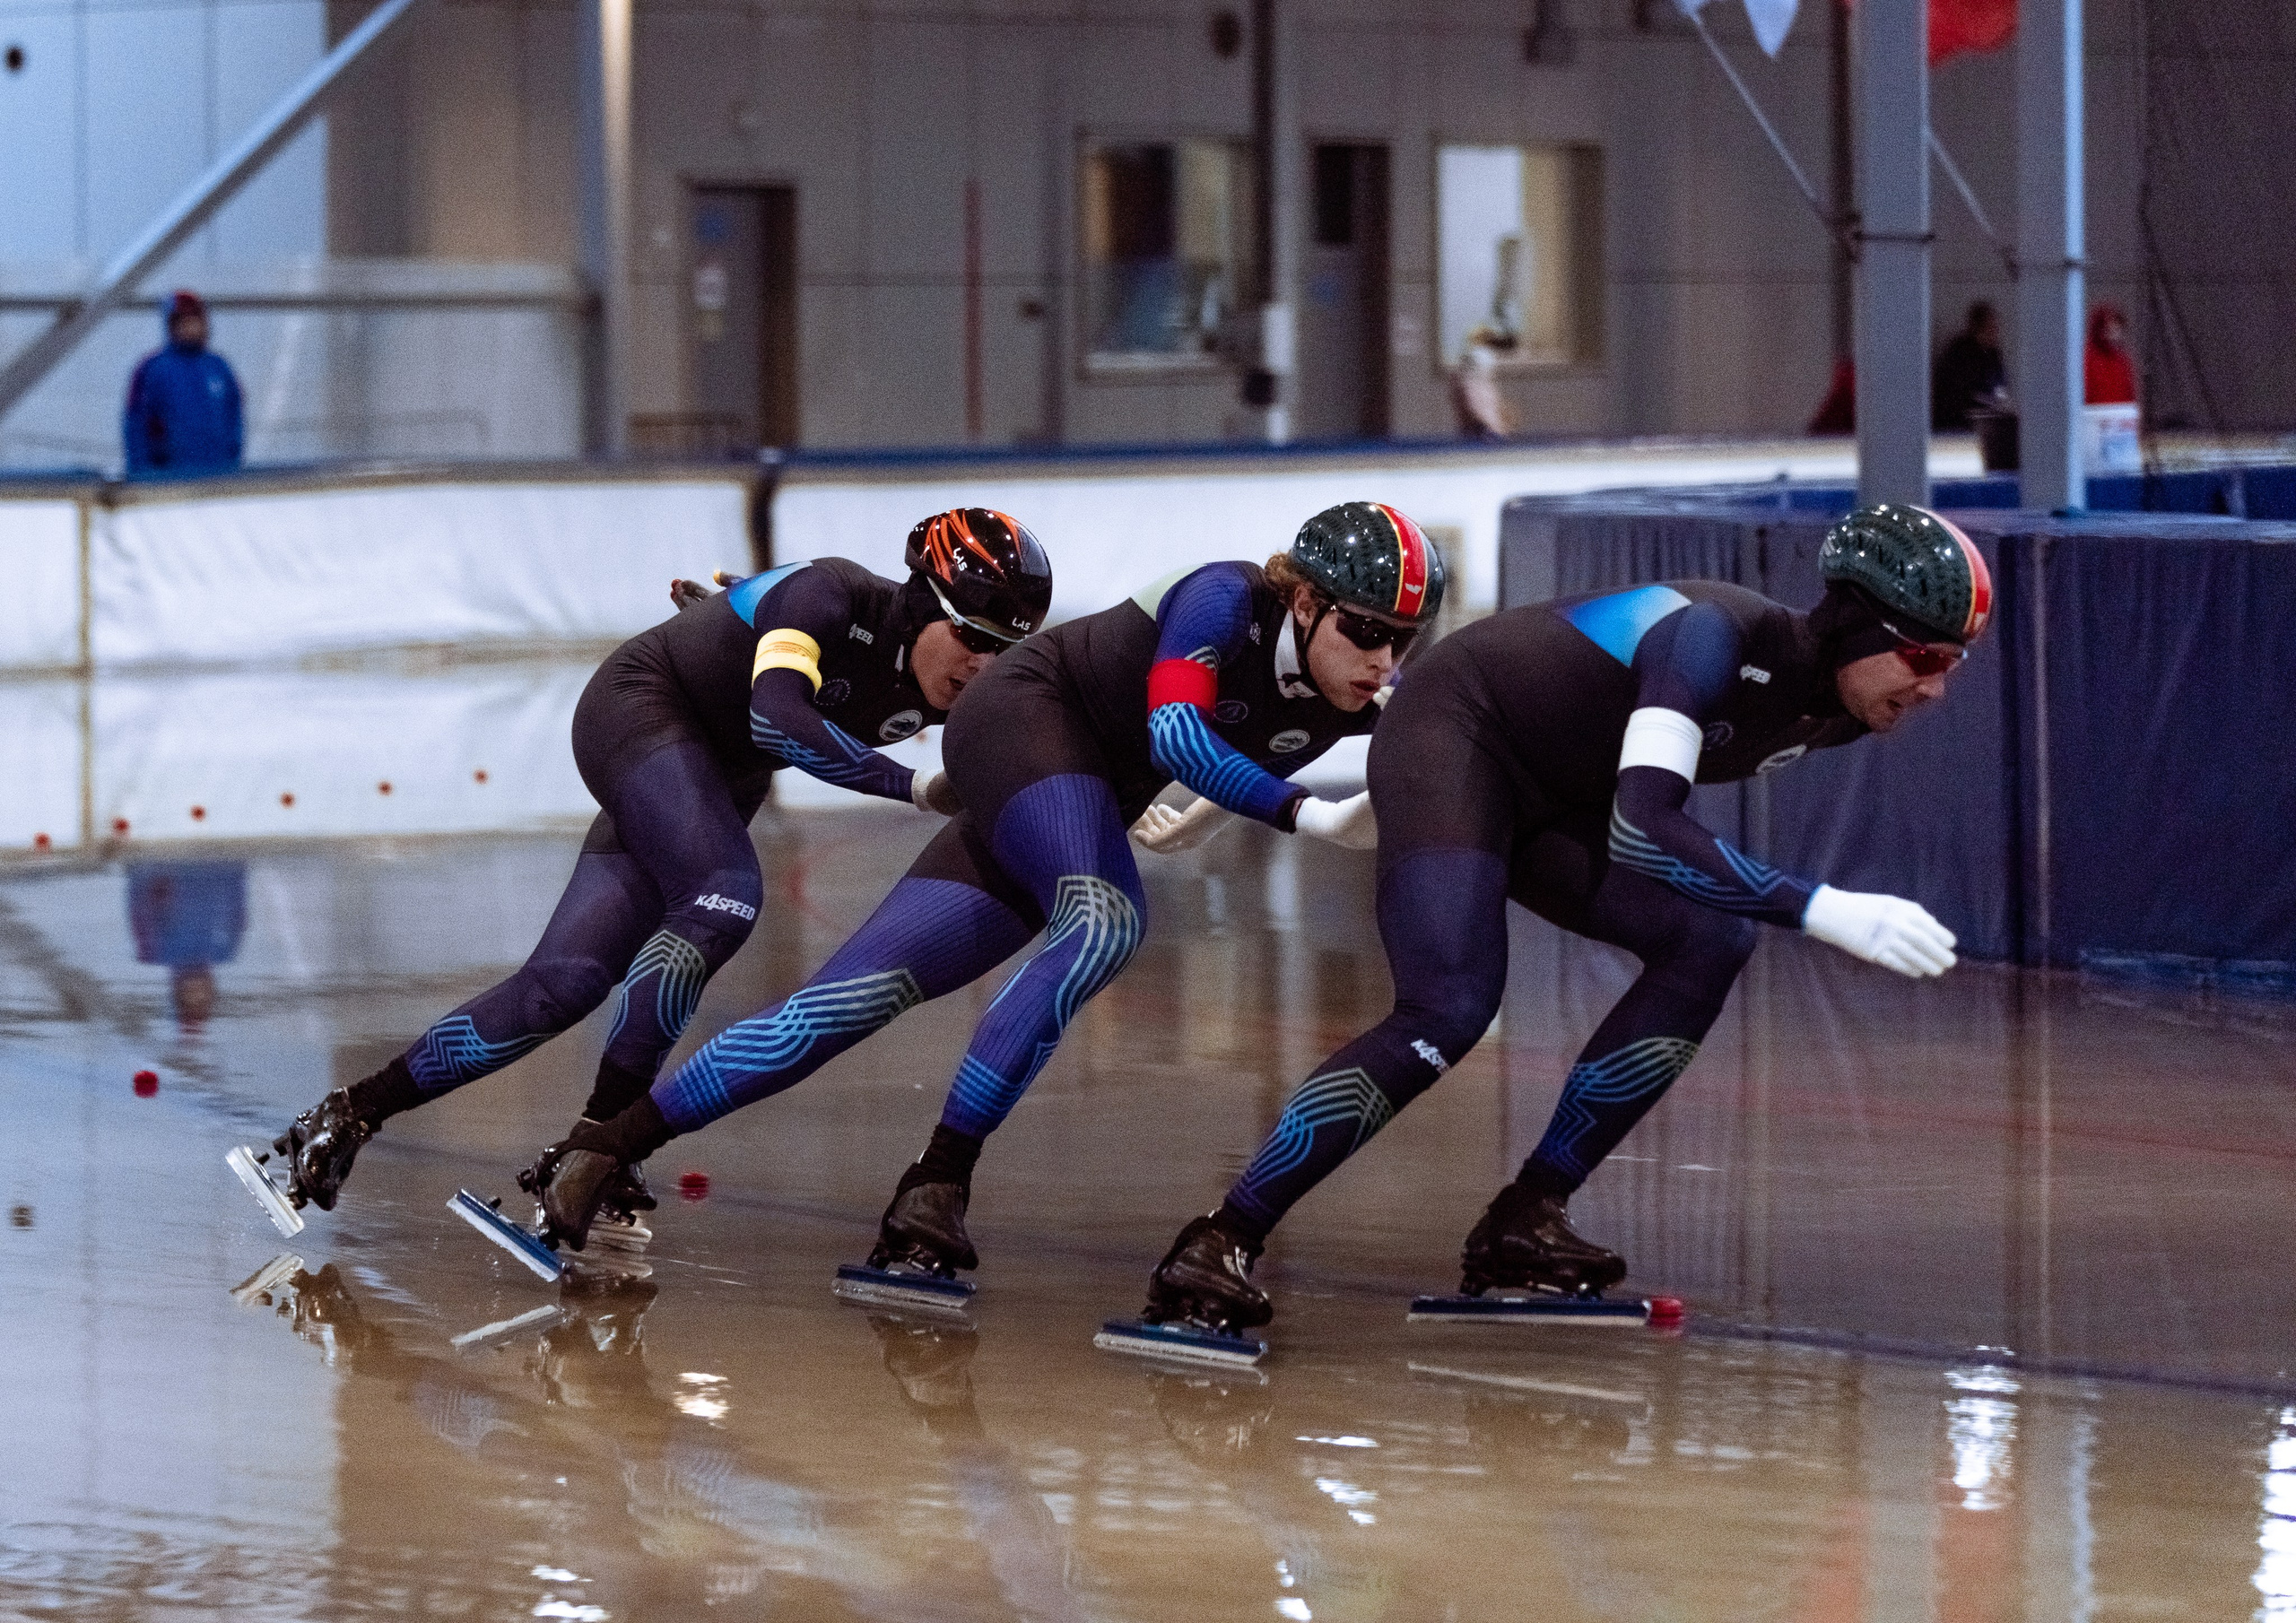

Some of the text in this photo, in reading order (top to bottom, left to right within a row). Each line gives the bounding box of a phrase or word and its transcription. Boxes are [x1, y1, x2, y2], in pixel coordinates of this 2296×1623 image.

[952, 547, 968, 572] LAS
[1012, 616, 1031, 631] LAS
[694, 893, 756, 921] K4SPEED
